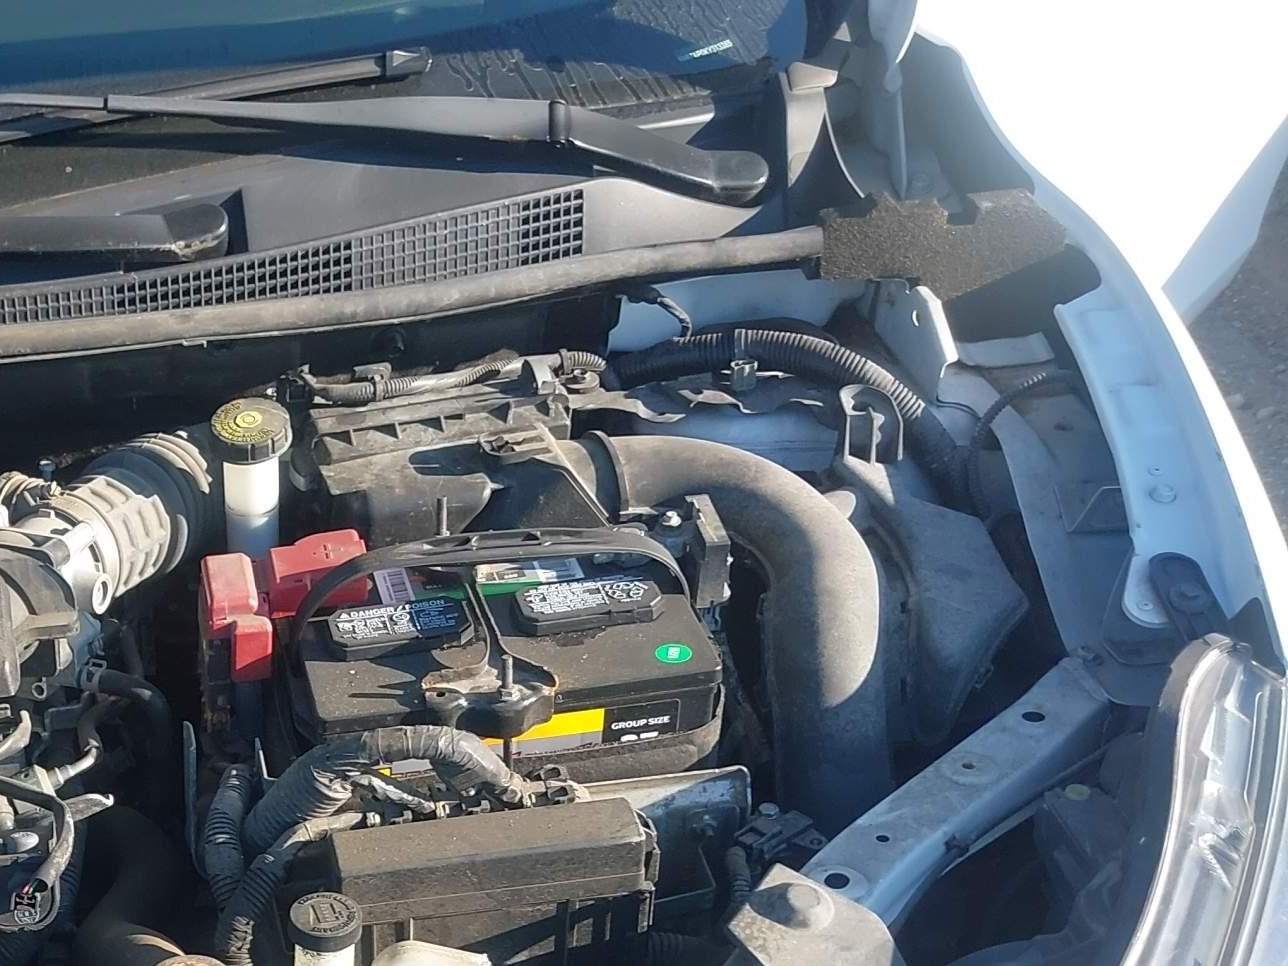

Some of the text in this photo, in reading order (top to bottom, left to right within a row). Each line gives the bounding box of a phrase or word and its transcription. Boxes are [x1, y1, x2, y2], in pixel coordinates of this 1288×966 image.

[351, 607, 394, 618] DANGER
[405, 599, 444, 610] POISON
[611, 715, 671, 730] GROUP SIZE
